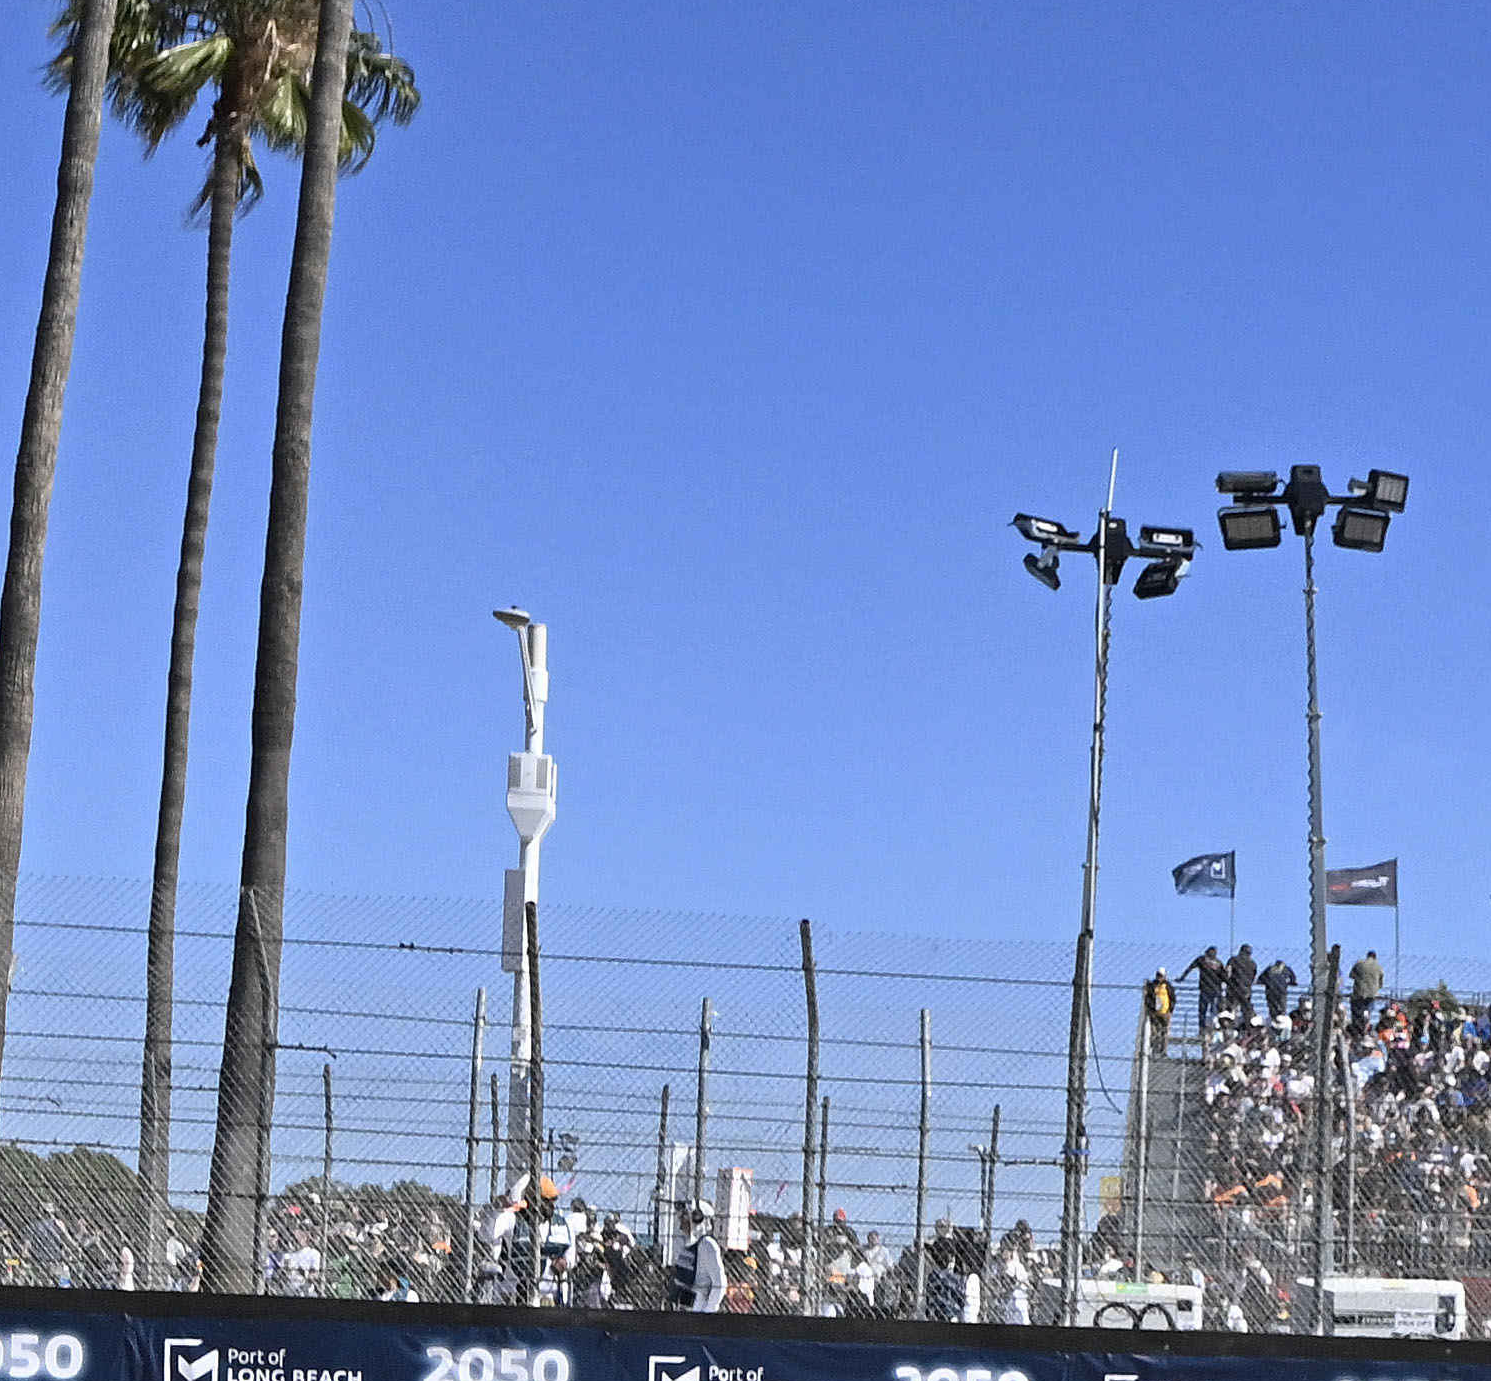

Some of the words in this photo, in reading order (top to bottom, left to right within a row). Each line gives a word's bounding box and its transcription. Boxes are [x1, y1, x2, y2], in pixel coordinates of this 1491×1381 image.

[228, 1349, 265, 1365] Port
[268, 1349, 286, 1367] of
[709, 1366, 744, 1381] Port
